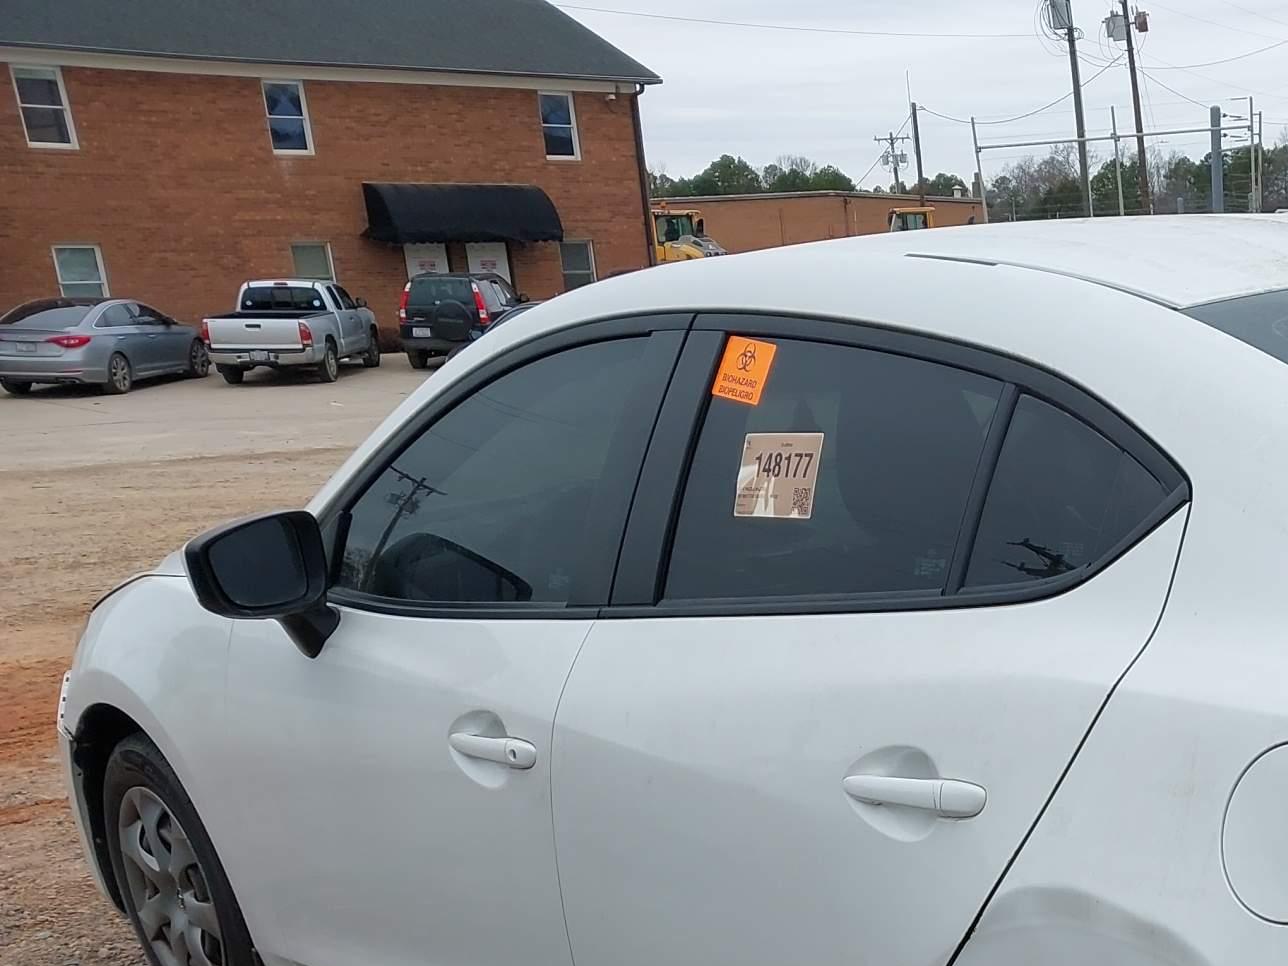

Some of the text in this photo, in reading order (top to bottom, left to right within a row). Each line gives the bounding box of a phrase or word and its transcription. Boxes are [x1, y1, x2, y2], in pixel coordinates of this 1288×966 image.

[722, 373, 757, 388] BIOHAZARD
[719, 385, 754, 400] BIOPELIGRO
[755, 452, 814, 478] 148177
